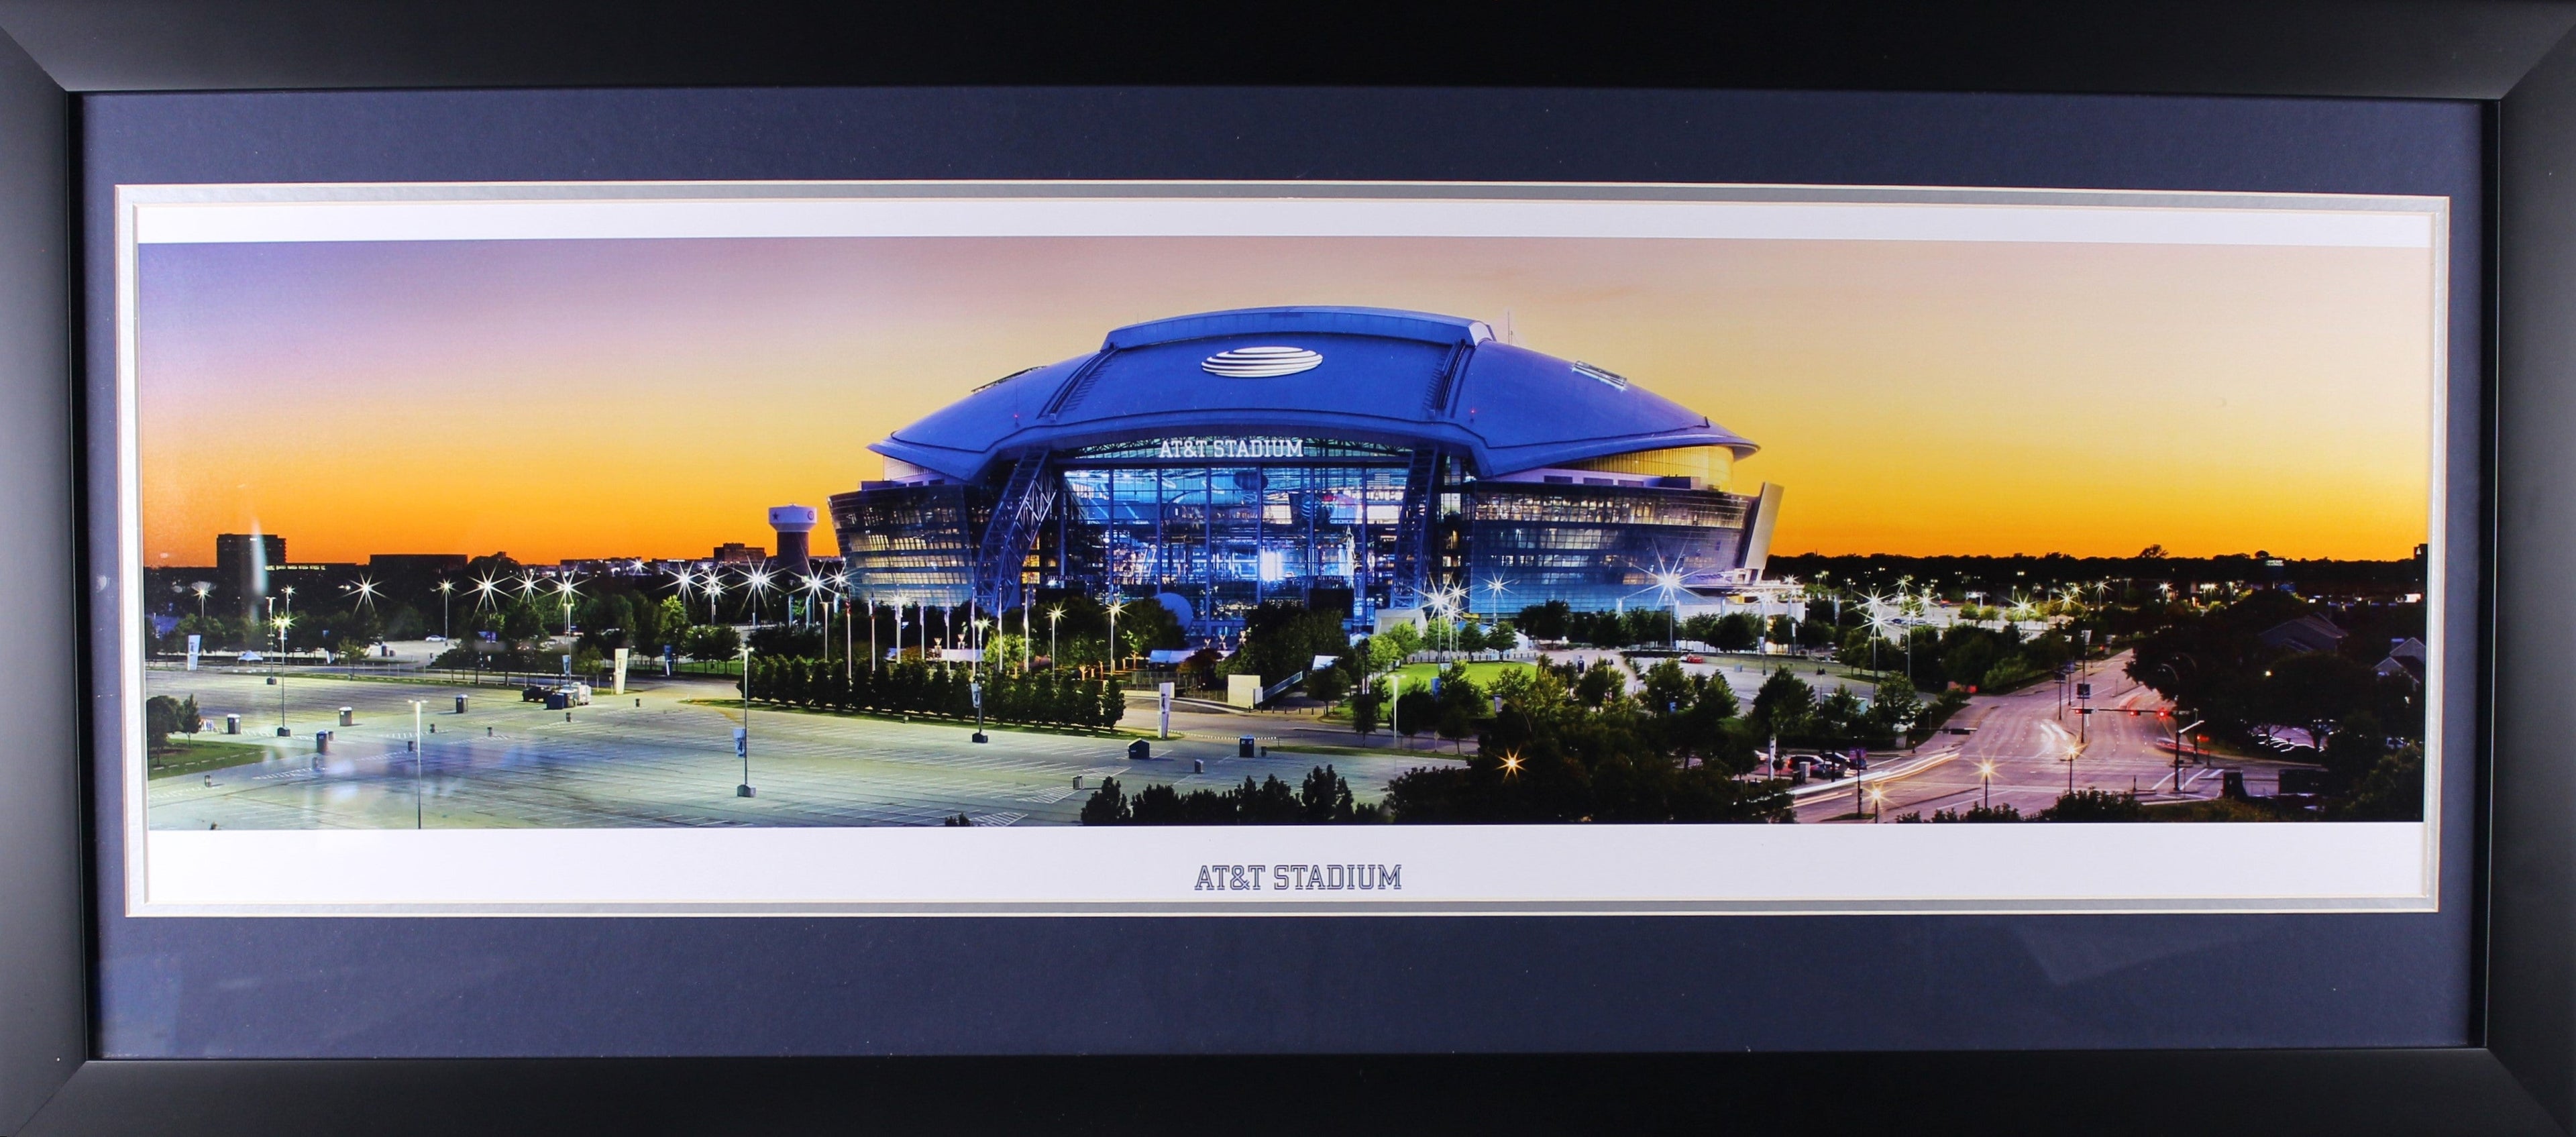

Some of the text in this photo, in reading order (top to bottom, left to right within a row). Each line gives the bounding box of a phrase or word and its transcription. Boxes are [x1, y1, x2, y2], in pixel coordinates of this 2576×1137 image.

[1159, 439, 1303, 458] AT&T STADIUM
[1194, 864, 1402, 890] AT&T STADIUM
